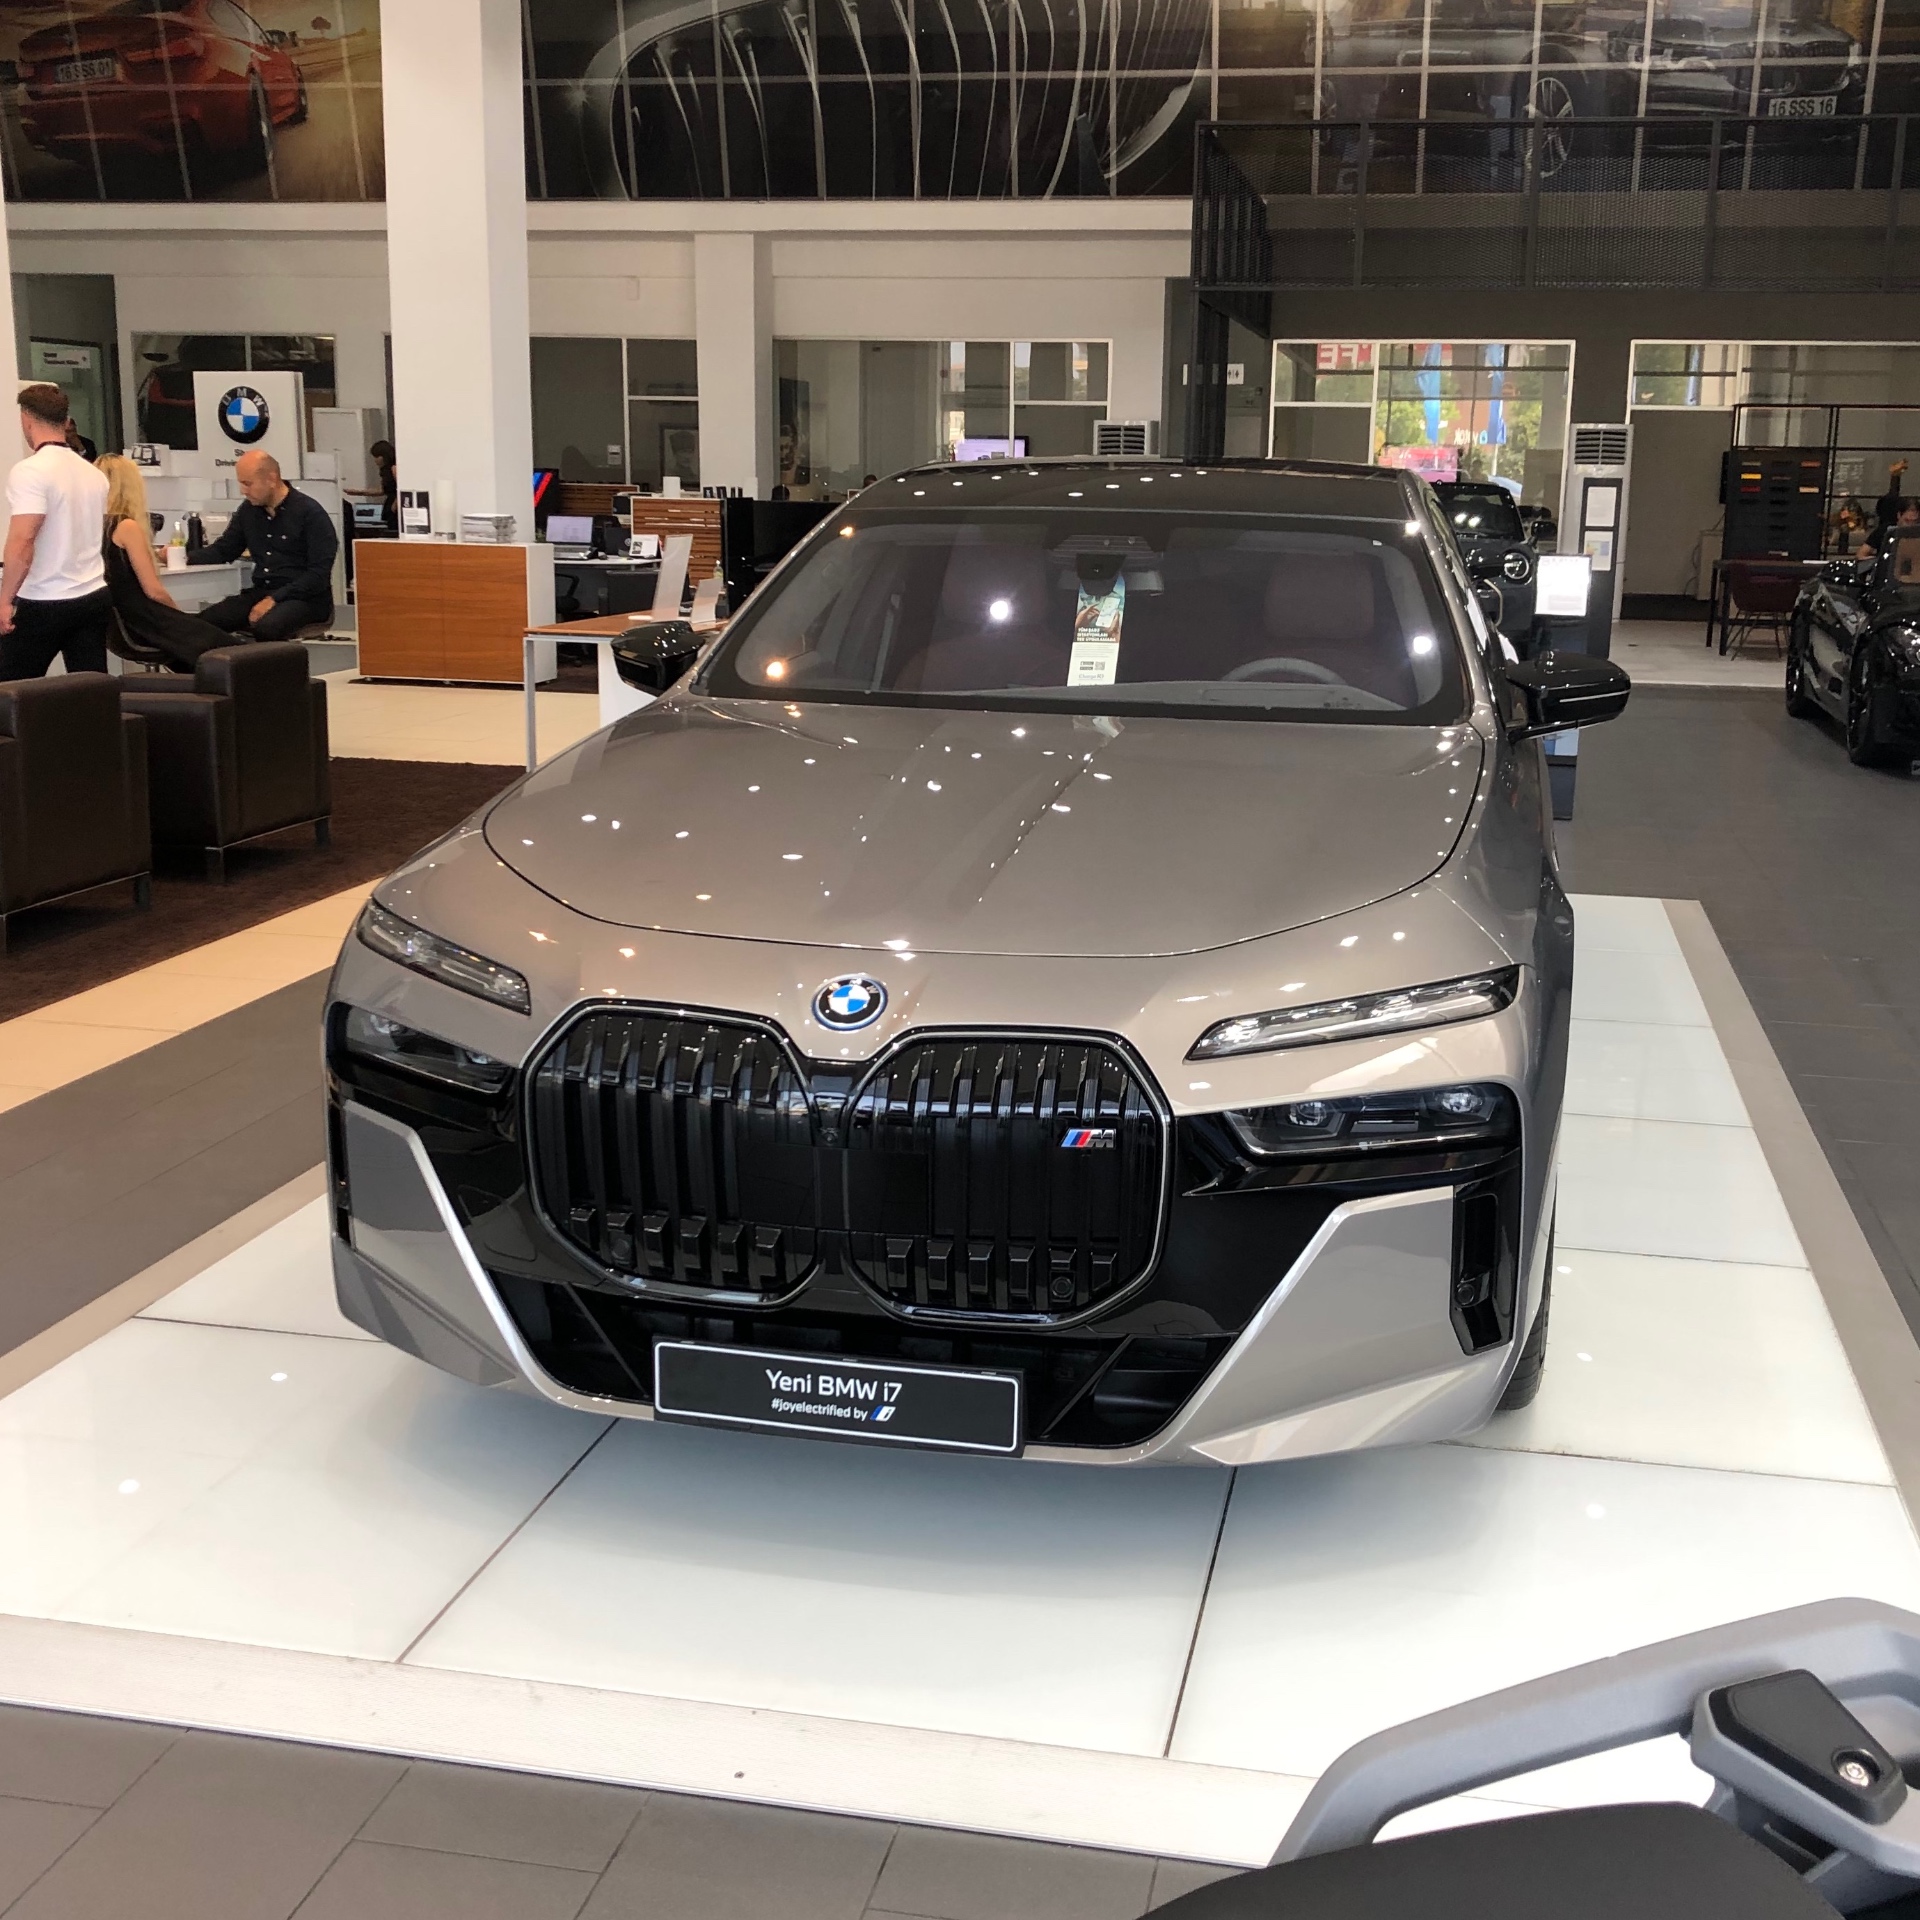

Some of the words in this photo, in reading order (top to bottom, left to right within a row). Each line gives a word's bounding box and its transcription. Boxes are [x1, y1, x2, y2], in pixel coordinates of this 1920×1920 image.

[1771, 100, 1786, 115] 16
[1789, 99, 1815, 115] SSS
[1819, 97, 1834, 114] 16
[765, 1368, 812, 1394] Yeni
[818, 1375, 878, 1401] BMW
[883, 1381, 903, 1403] i7
[771, 1398, 851, 1418] #joyelectrified
[853, 1407, 868, 1421] by
